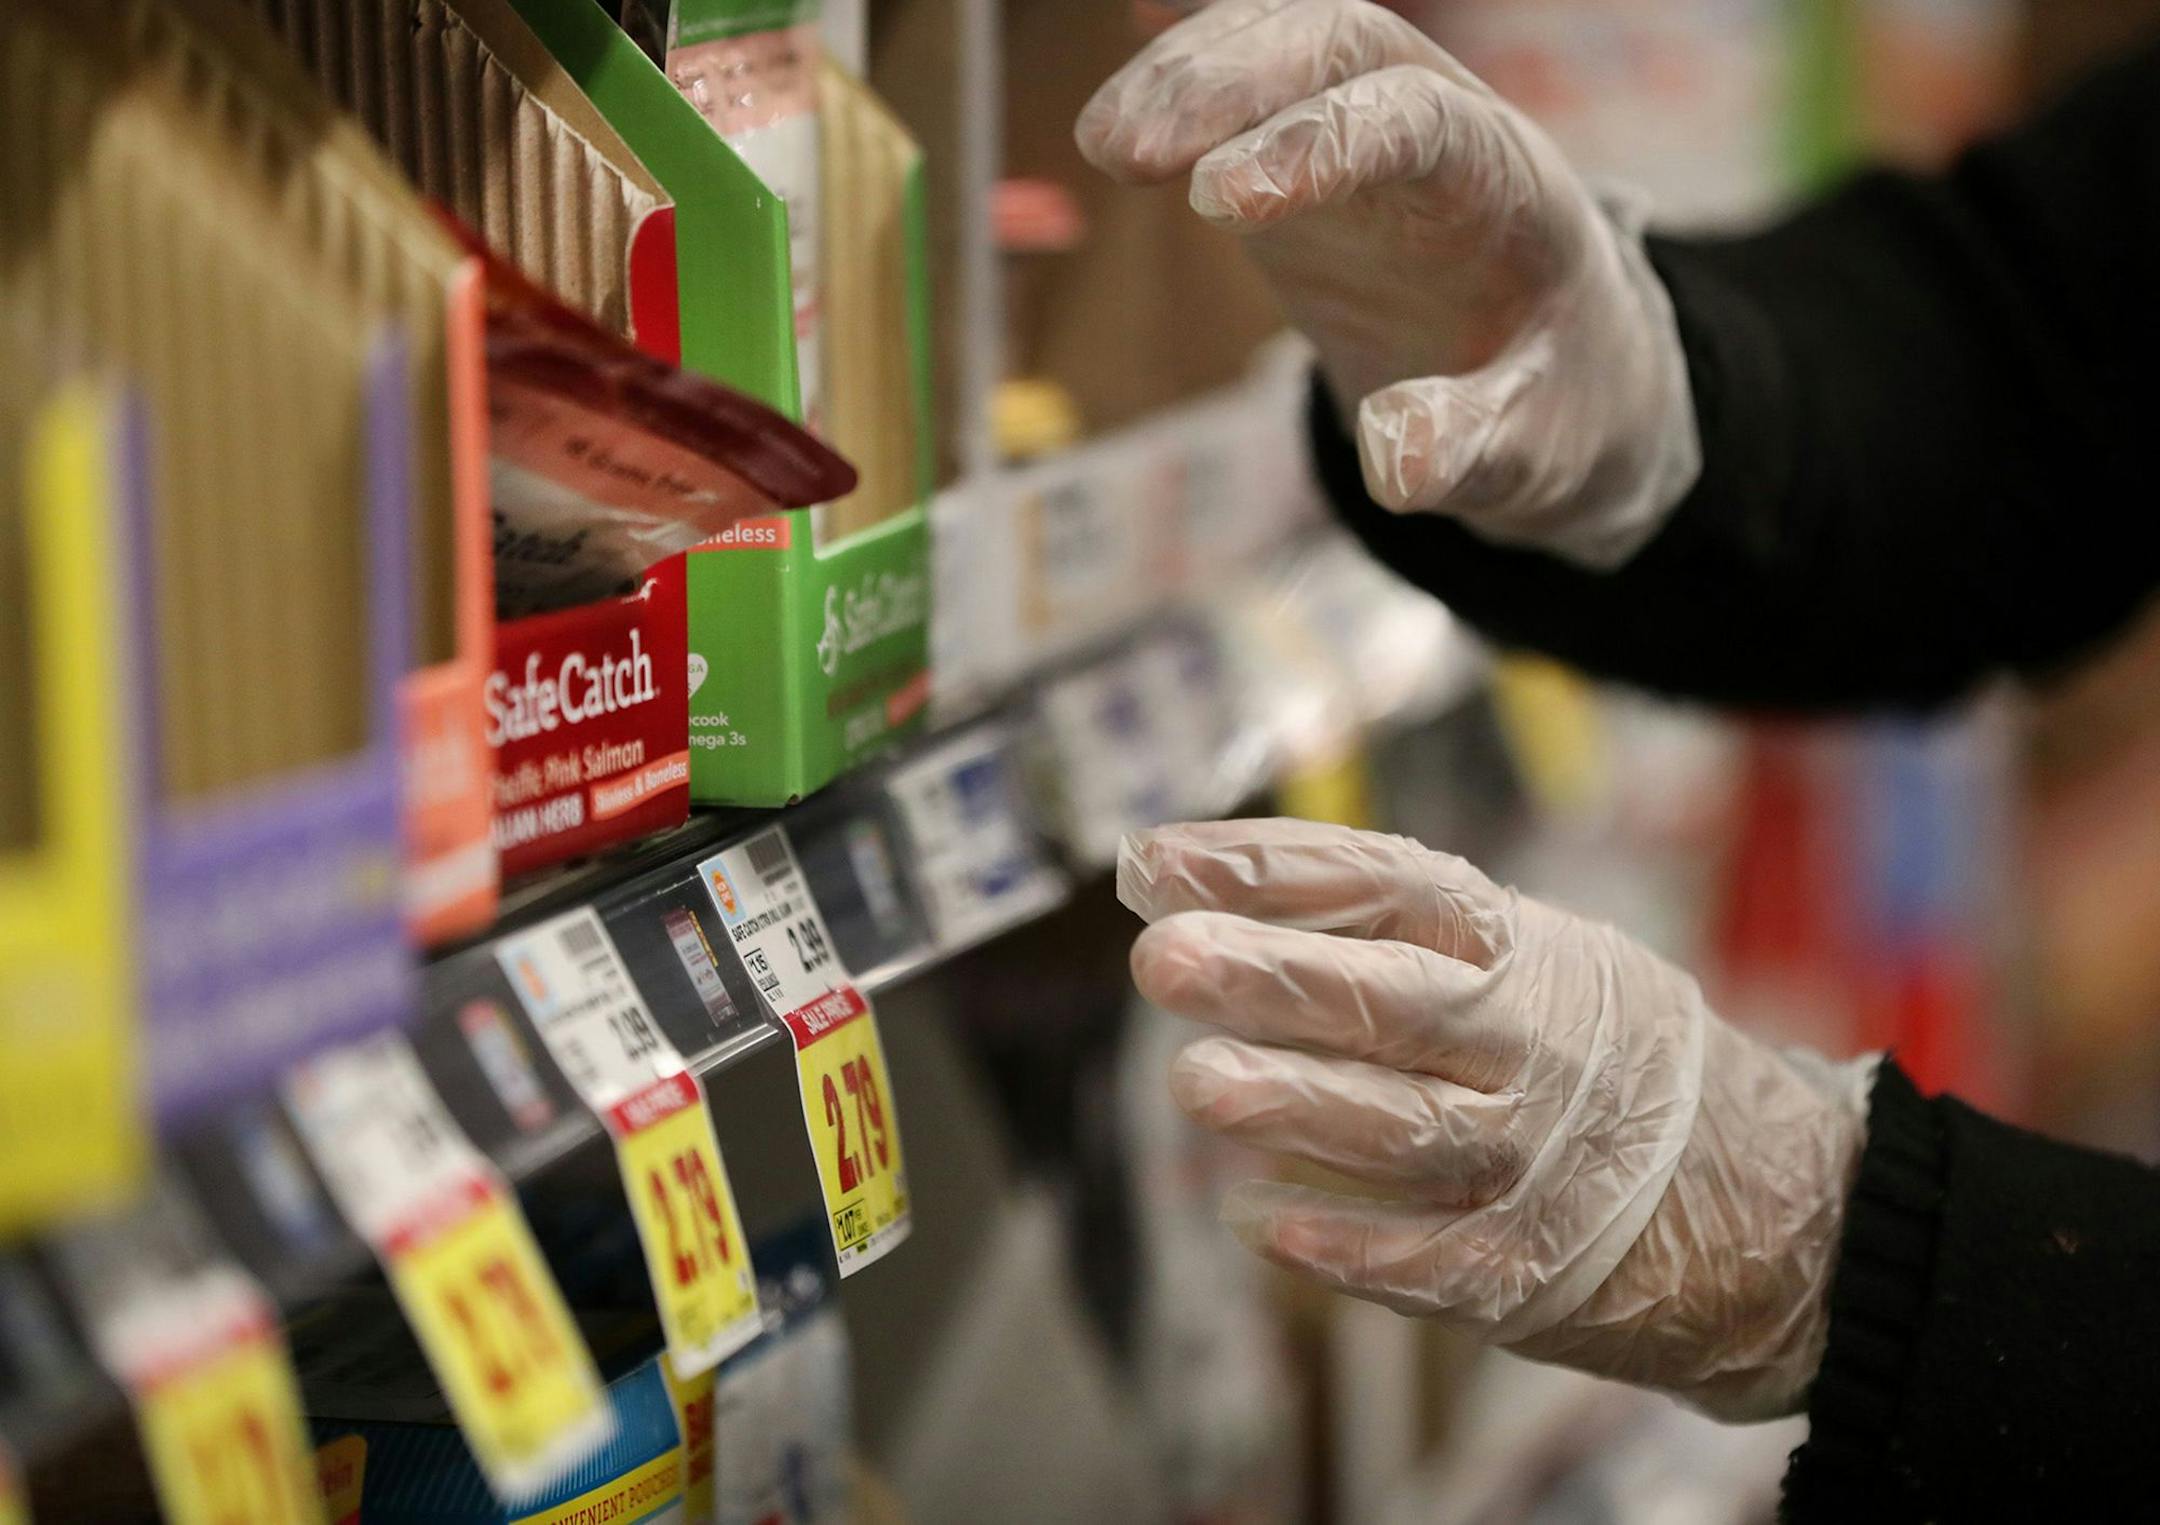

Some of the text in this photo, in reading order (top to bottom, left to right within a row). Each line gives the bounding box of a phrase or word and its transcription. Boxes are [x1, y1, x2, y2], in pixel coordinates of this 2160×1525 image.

[696, 522, 777, 545] eless
[689, 712, 729, 727] cook
[729, 731, 747, 746] 3s
[583, 738, 645, 781] Salmon
[801, 1004, 830, 1036] SALE
[822, 1054, 888, 1194] 2.79
[551, 1491, 625, 1525] VENIENT
